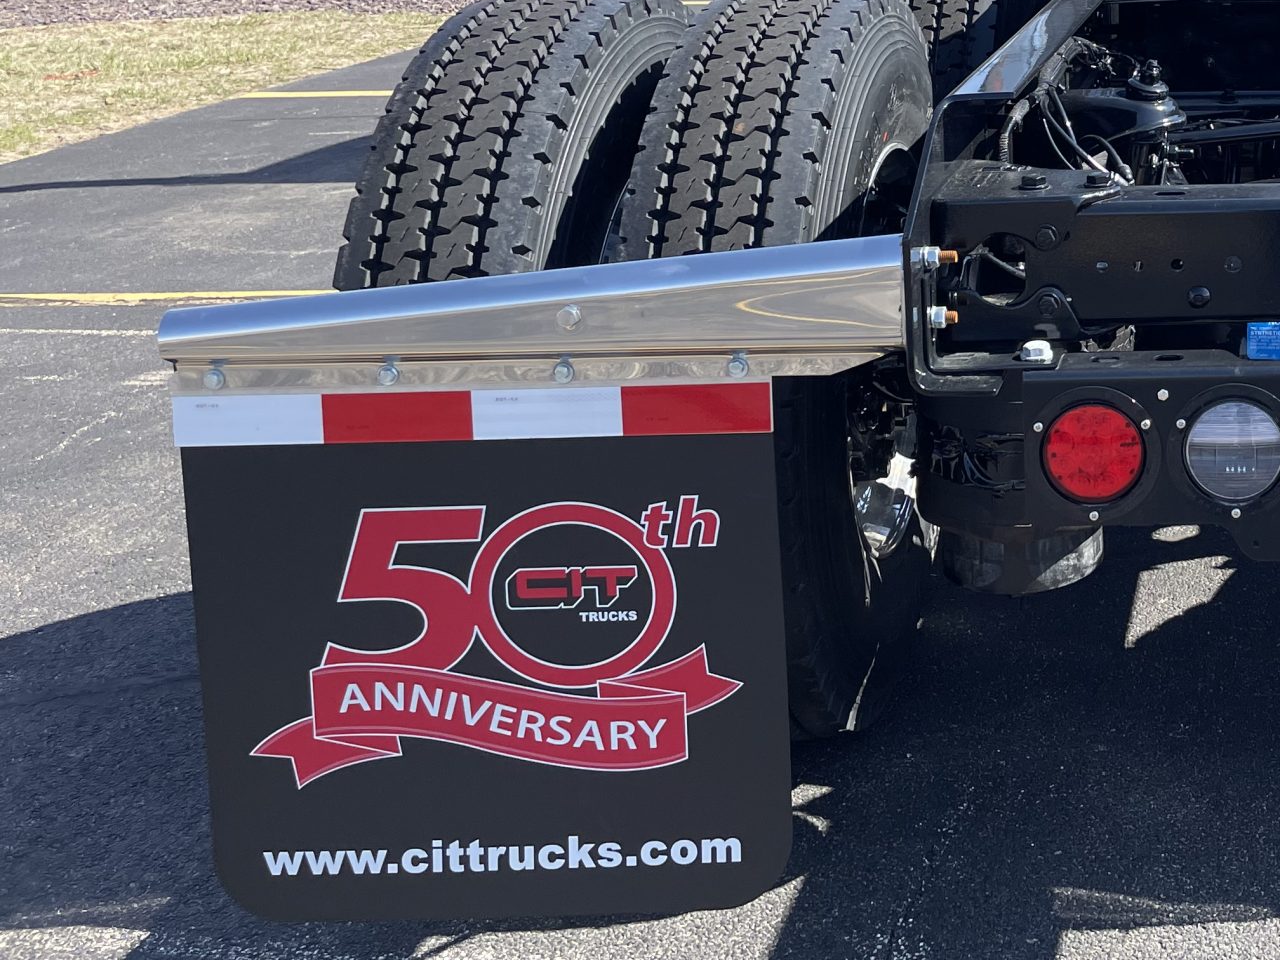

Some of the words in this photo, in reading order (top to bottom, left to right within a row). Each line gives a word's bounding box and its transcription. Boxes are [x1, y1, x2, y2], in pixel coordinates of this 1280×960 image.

[505, 565, 638, 610] CIT
[579, 610, 637, 623] TRUCKS
[339, 680, 667, 752] ANNIVERSARY
[263, 836, 742, 876] www.cittrucks.com
